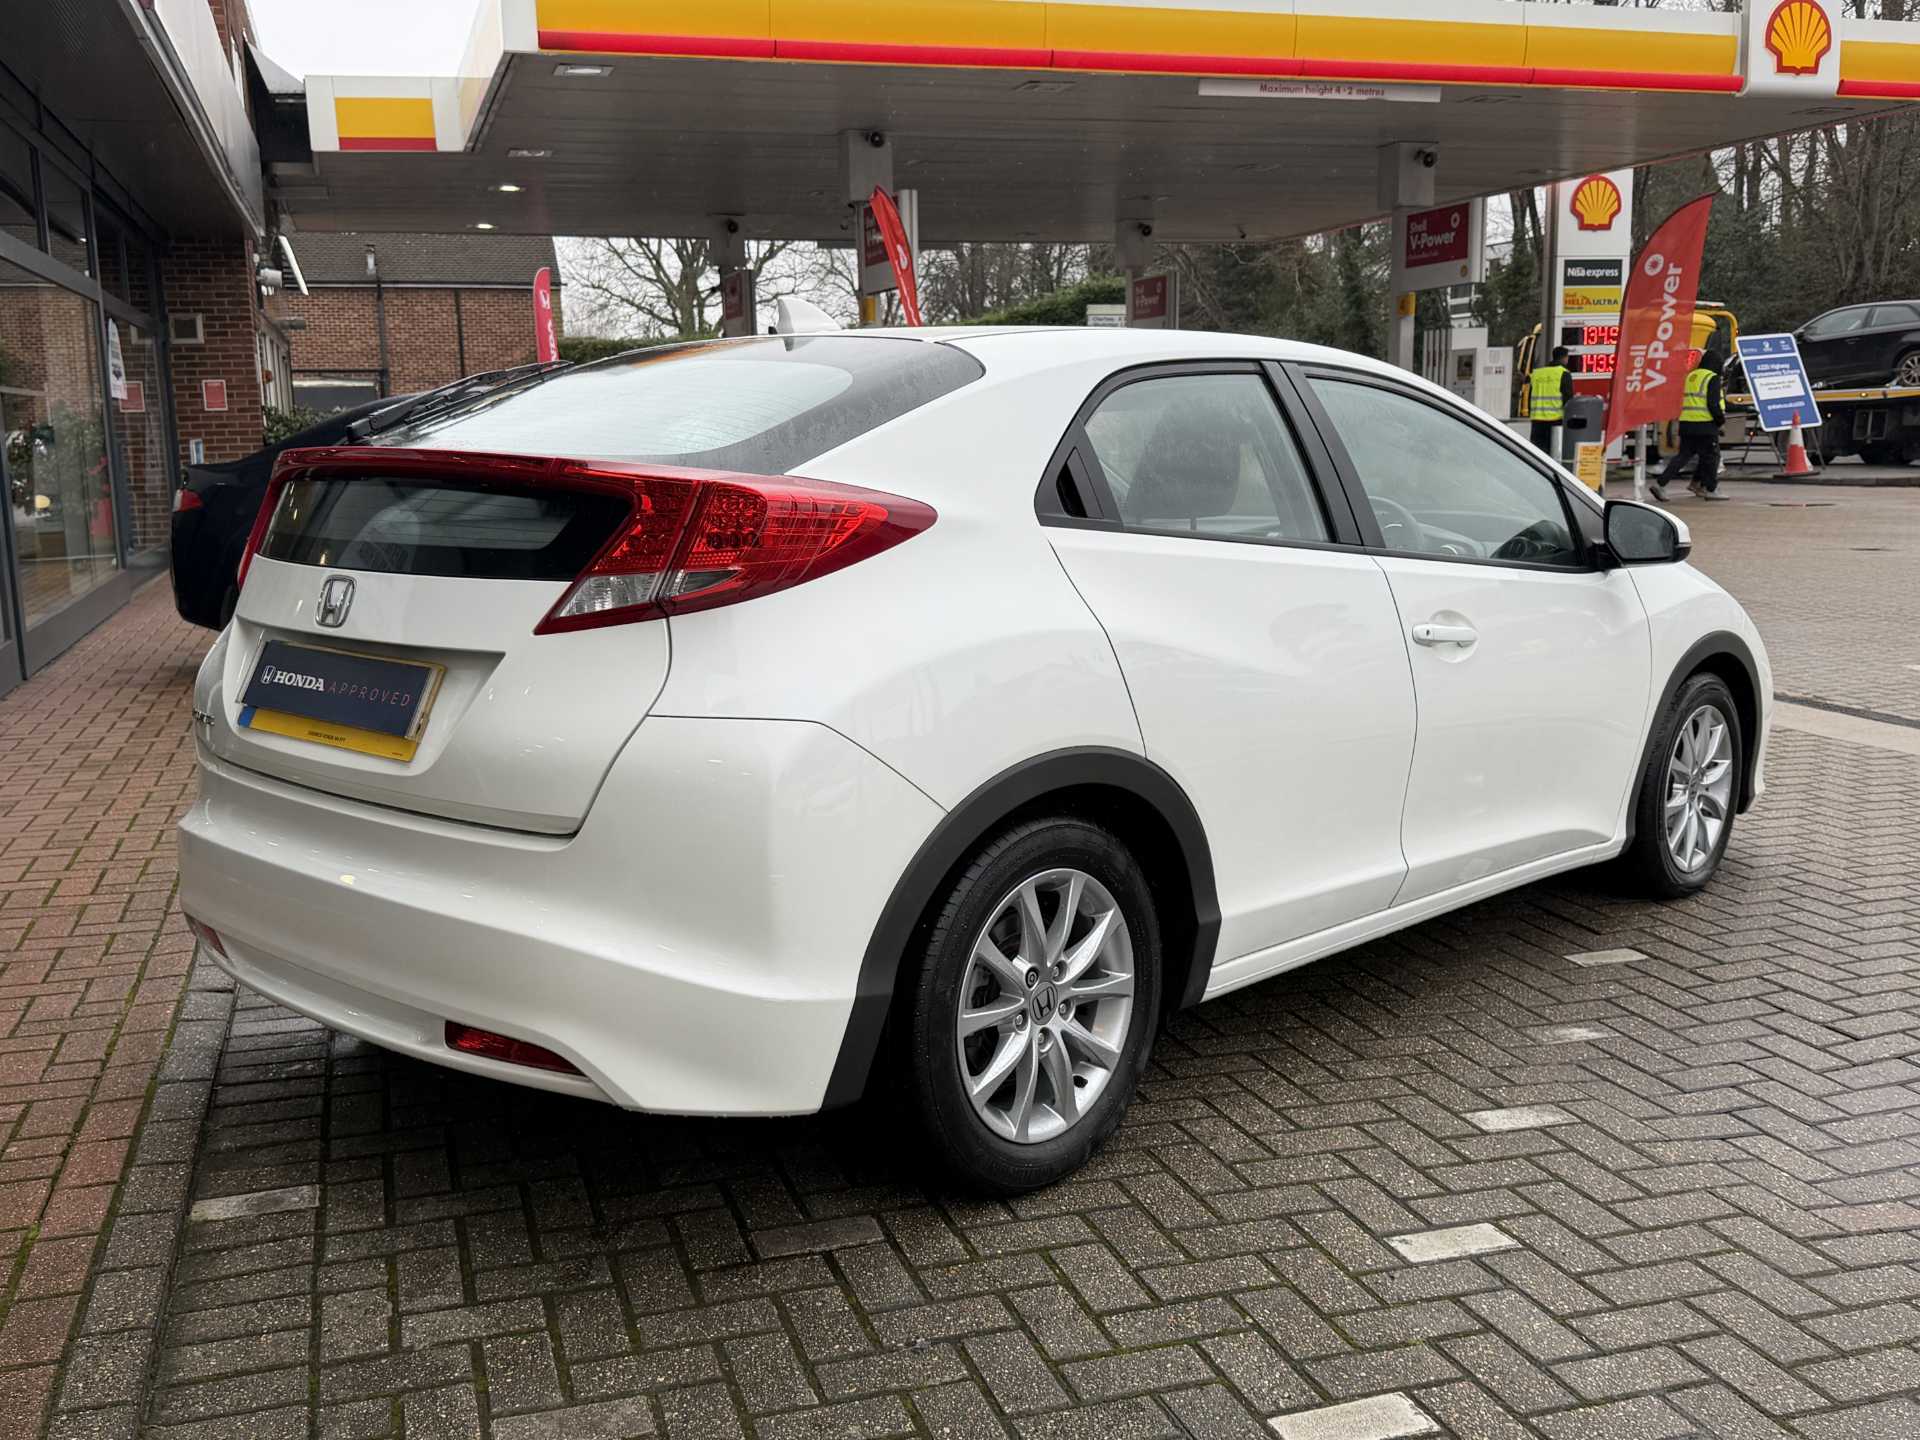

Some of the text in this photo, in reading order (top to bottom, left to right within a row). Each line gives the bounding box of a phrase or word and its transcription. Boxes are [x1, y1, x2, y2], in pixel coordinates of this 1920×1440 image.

[1260, 82, 1301, 95] Maximum
[1409, 231, 1456, 250] V-Power
[1586, 268, 1619, 278] express
[1643, 262, 1683, 392] V-Power
[1626, 344, 1647, 393] Shell
[272, 670, 411, 707] HONDA APPROVED
